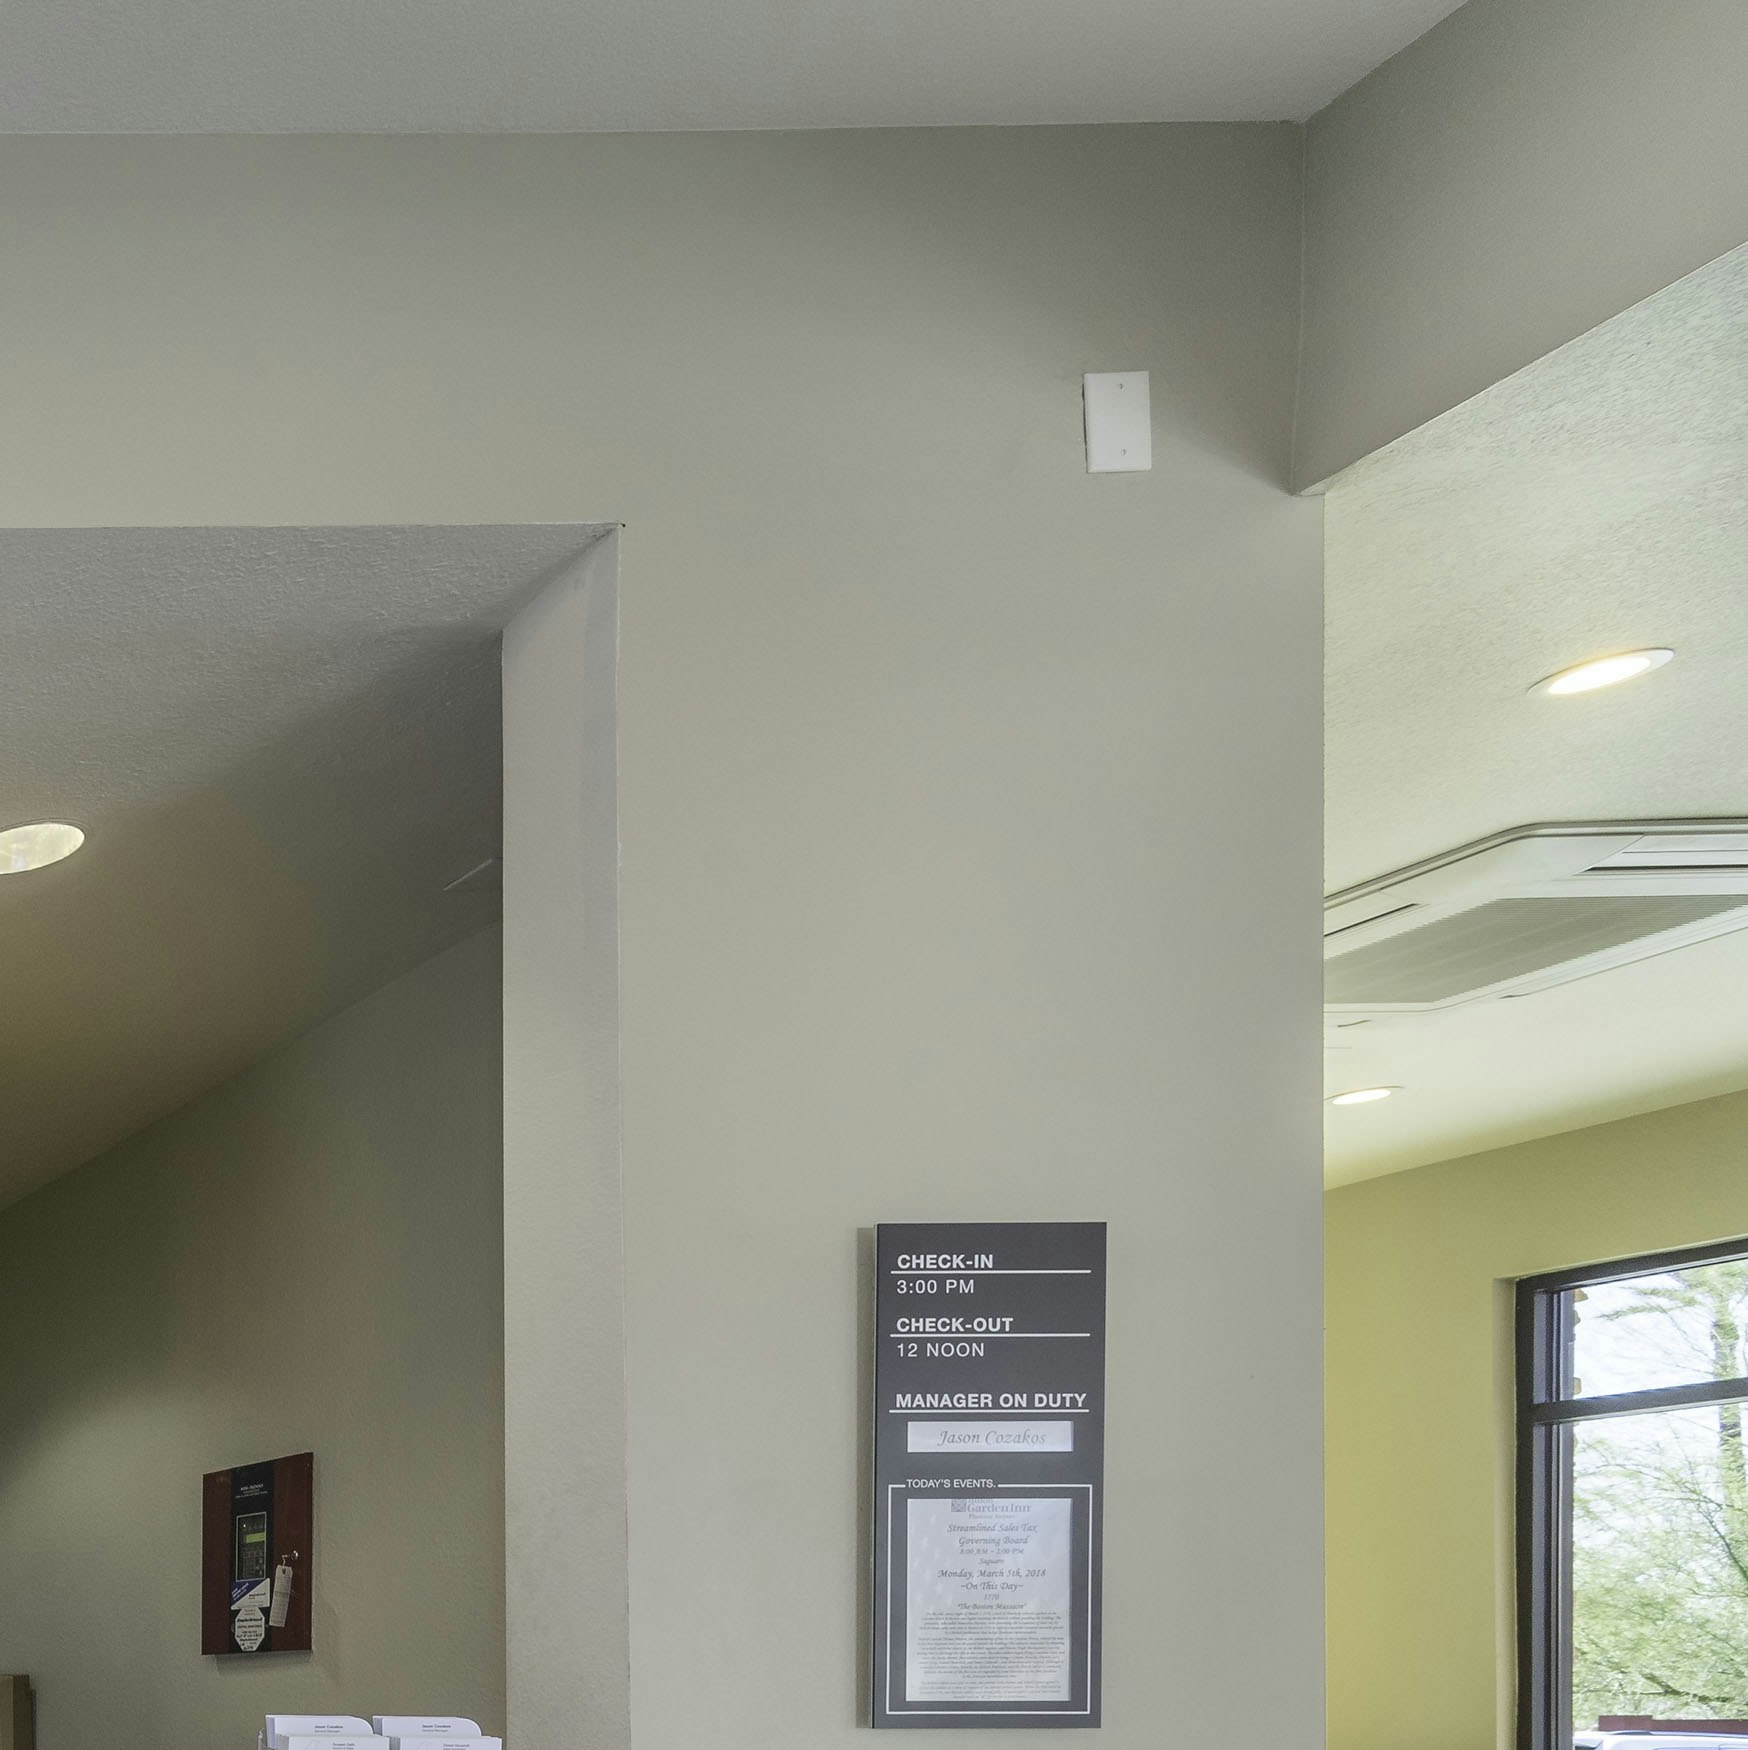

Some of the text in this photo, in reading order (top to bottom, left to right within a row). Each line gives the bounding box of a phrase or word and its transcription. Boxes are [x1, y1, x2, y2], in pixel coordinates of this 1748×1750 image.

[897, 1254, 993, 1269] CHECK-IN
[896, 1279, 974, 1294] 3:00 PM
[896, 1318, 1013, 1332] CHECK-OUT
[897, 1343, 984, 1357] 12 NOON
[896, 1393, 1087, 1408] MANAGER ON DUTY
[937, 1429, 1046, 1446] Jason Cozakos
[906, 1479, 951, 1488] TODAY'S
[947, 1523, 1039, 1533] Streamlined Sales Tax
[958, 1536, 1029, 1547] Governing Board
[937, 1569, 975, 1579] Monday,
[977, 1569, 1004, 1578] March
[1025, 1569, 1046, 1577] 2018
[980, 1582, 997, 1590] This
